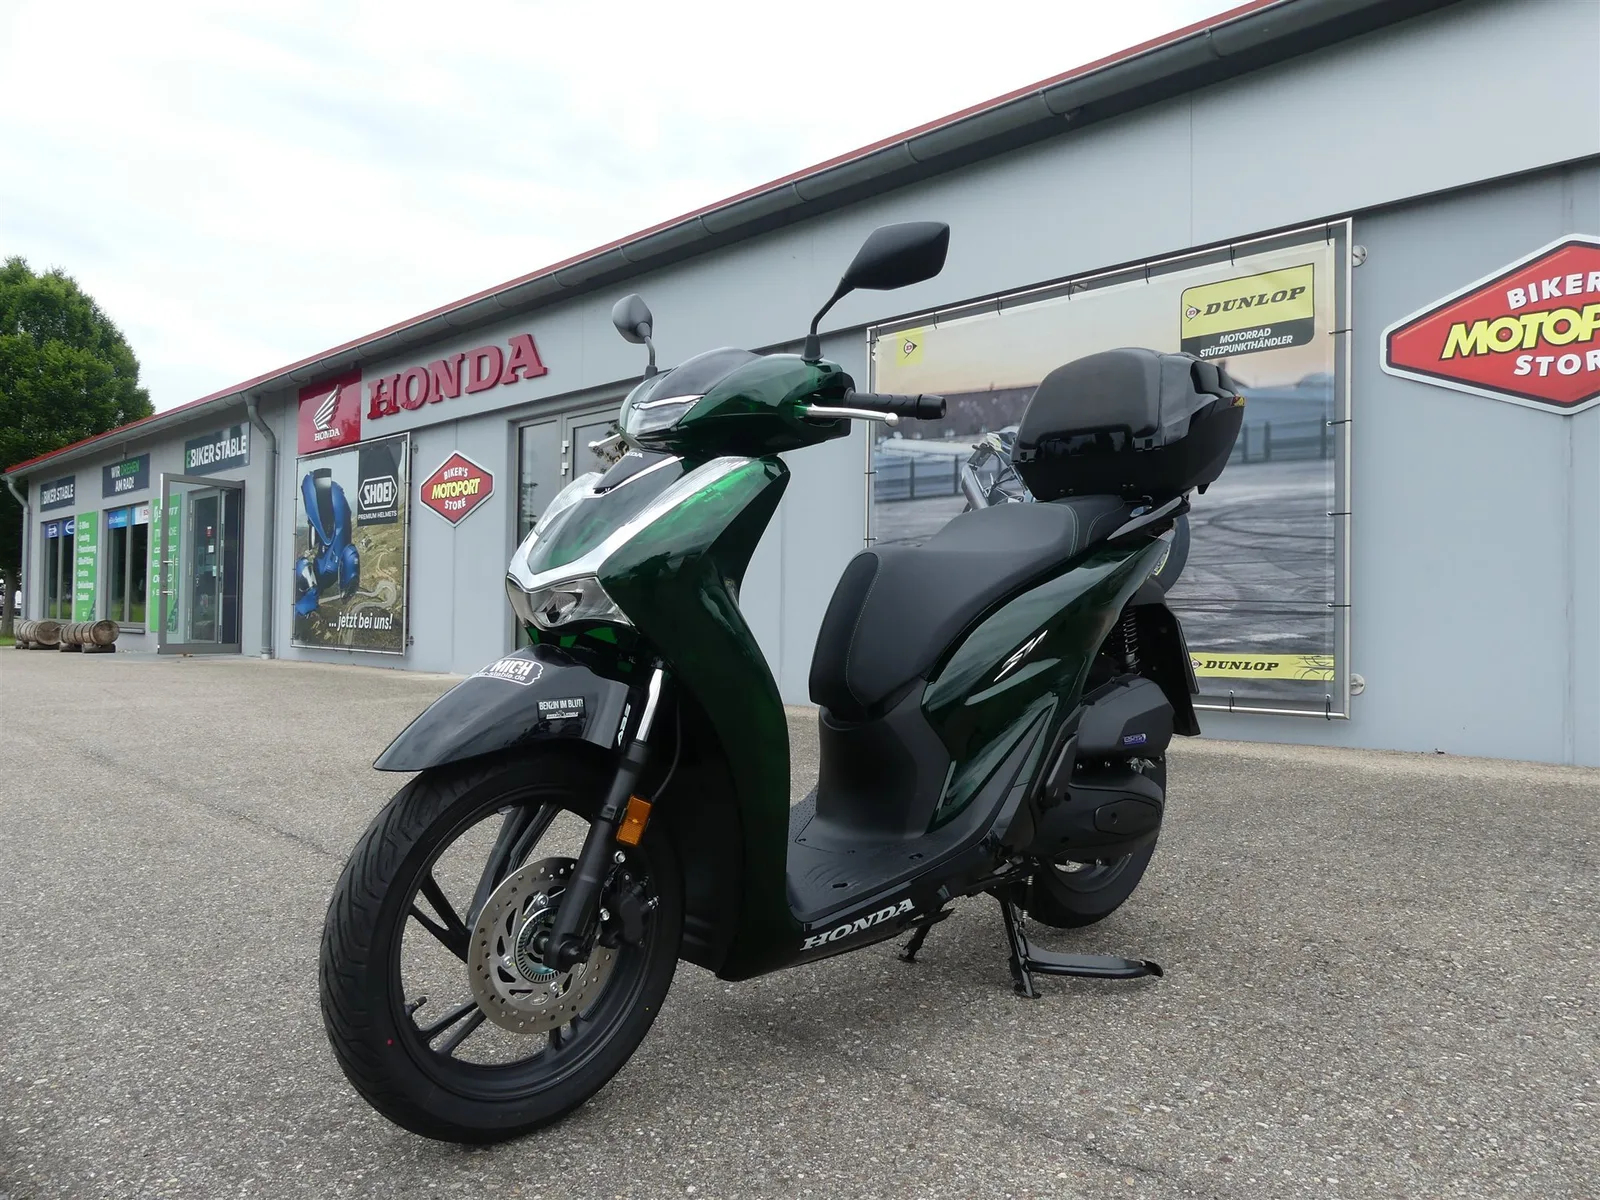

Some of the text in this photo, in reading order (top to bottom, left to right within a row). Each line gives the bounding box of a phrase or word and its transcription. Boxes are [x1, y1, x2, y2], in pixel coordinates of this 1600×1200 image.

[1203, 286, 1306, 316] DUNLOP
[1199, 334, 1294, 358] STÜTZPUNKTHÄNDLER
[1219, 328, 1272, 345] MOTORRAD
[367, 334, 547, 419] HONDA
[314, 427, 341, 442] HONDA
[215, 435, 246, 460] STABLE
[443, 466, 469, 480] BIKER'S
[363, 481, 393, 505] SHOEI
[431, 477, 481, 500] MOTOPORT
[444, 497, 467, 511] STORE
[377, 509, 398, 519] HELMETS
[336, 611, 358, 632] jetzt
[358, 612, 373, 629] bei
[373, 612, 393, 630] uns!
[490, 659, 534, 675] MICH
[1204, 659, 1279, 671] DUNLOP
[539, 701, 559, 710] BENZIN
[559, 699, 568, 709] IM
[800, 898, 915, 950] HONDA
